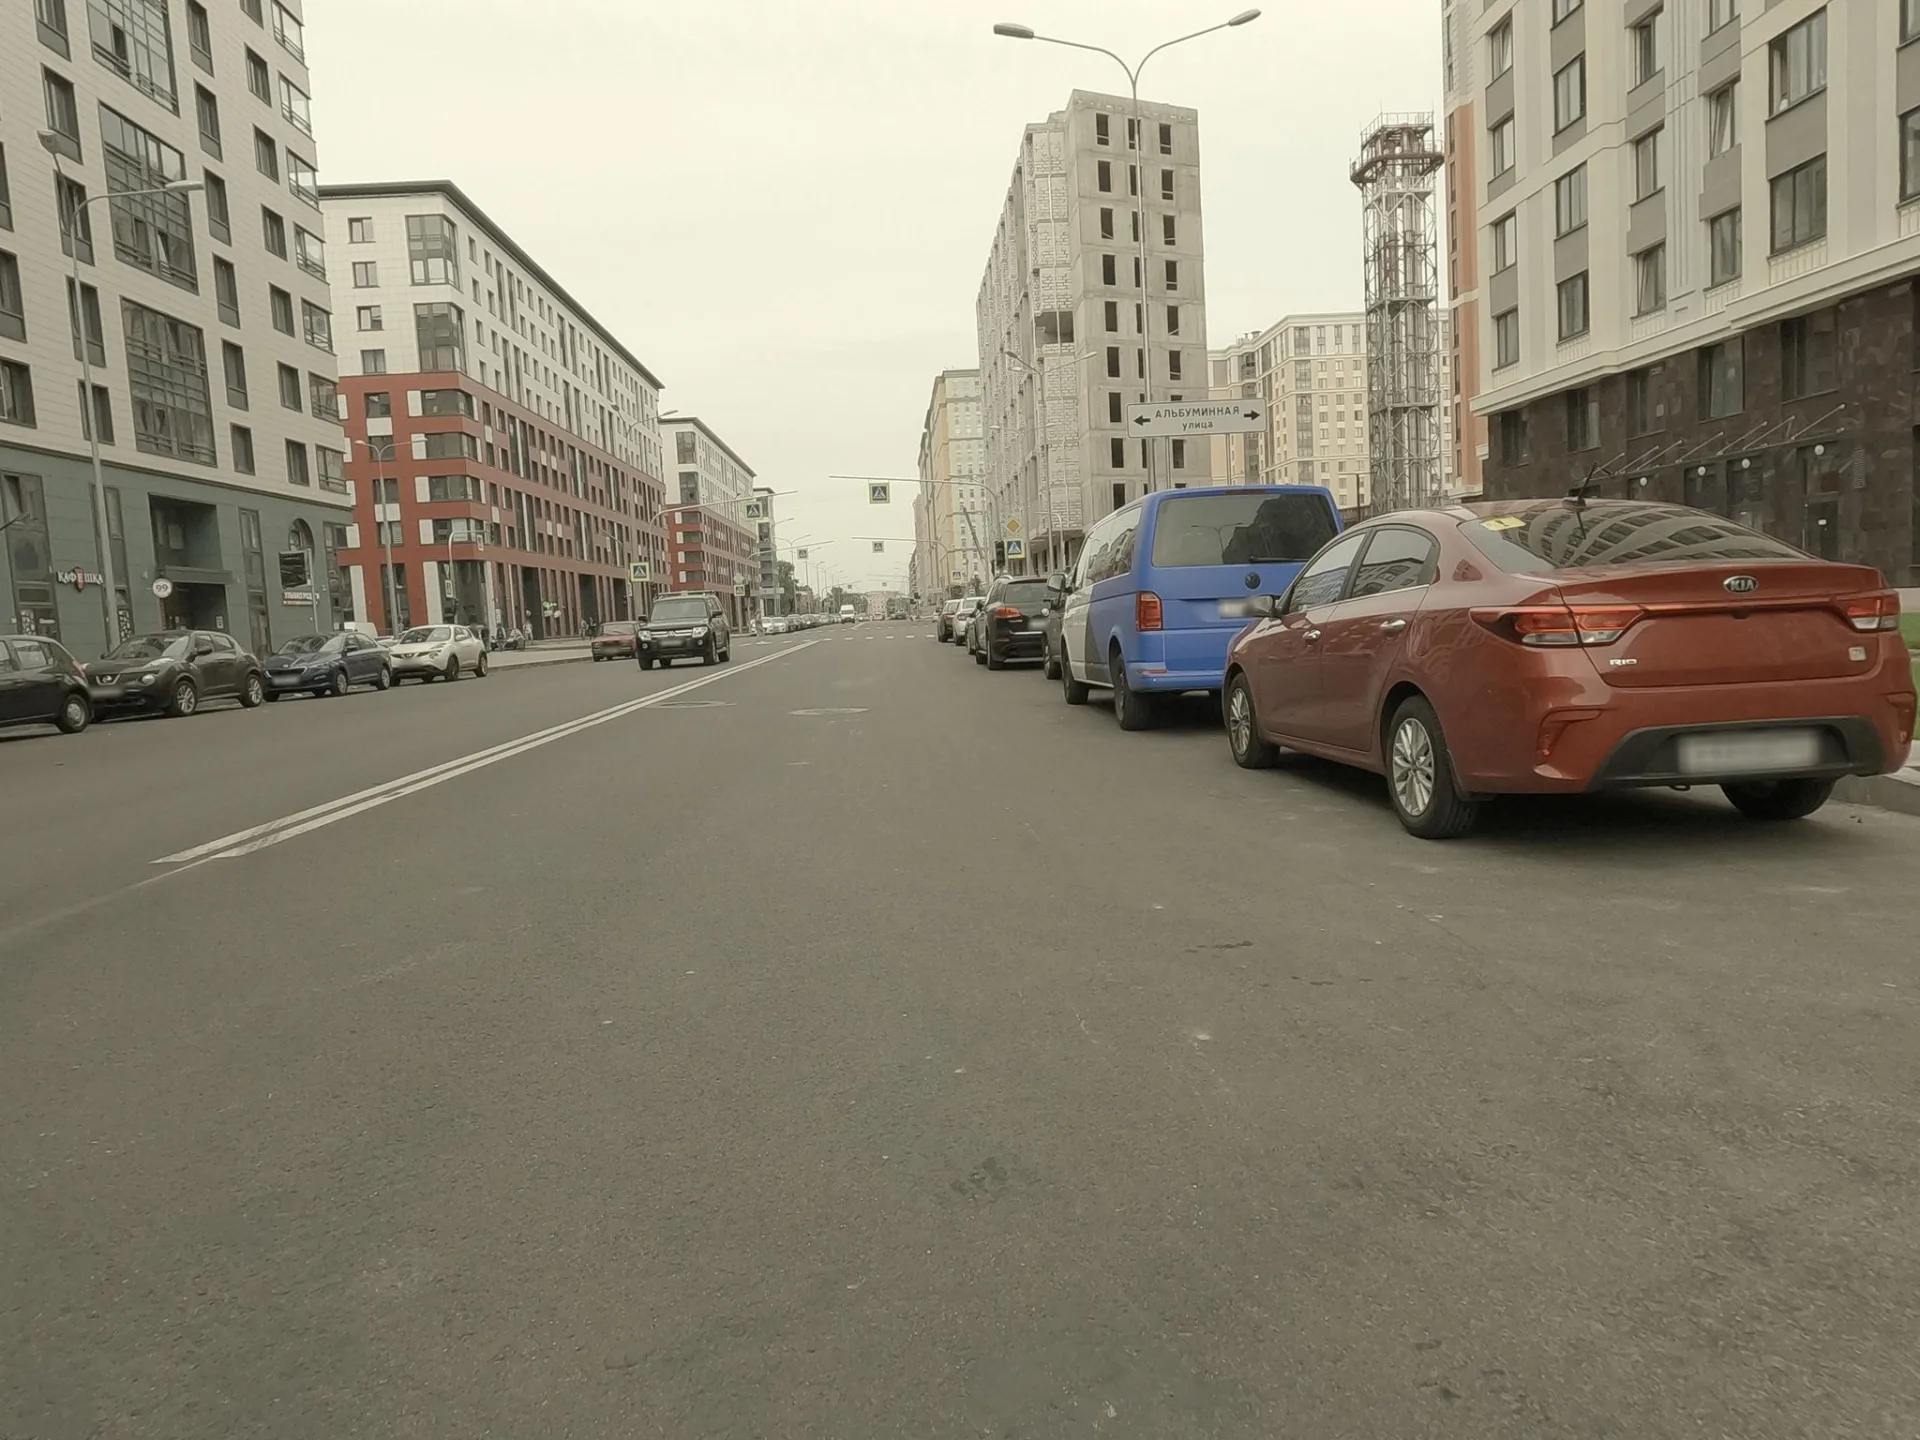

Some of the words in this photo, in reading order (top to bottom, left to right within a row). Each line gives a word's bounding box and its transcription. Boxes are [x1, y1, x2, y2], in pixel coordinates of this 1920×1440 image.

[1155, 406, 1240, 419] АЛЬБУМИННАЯ
[1182, 420, 1213, 431] улица
[57, 571, 104, 585] КАФЕШКА
[155, 584, 168, 593] 99
[1730, 579, 1754, 591] KIA
[1609, 658, 1638, 666] RIO
